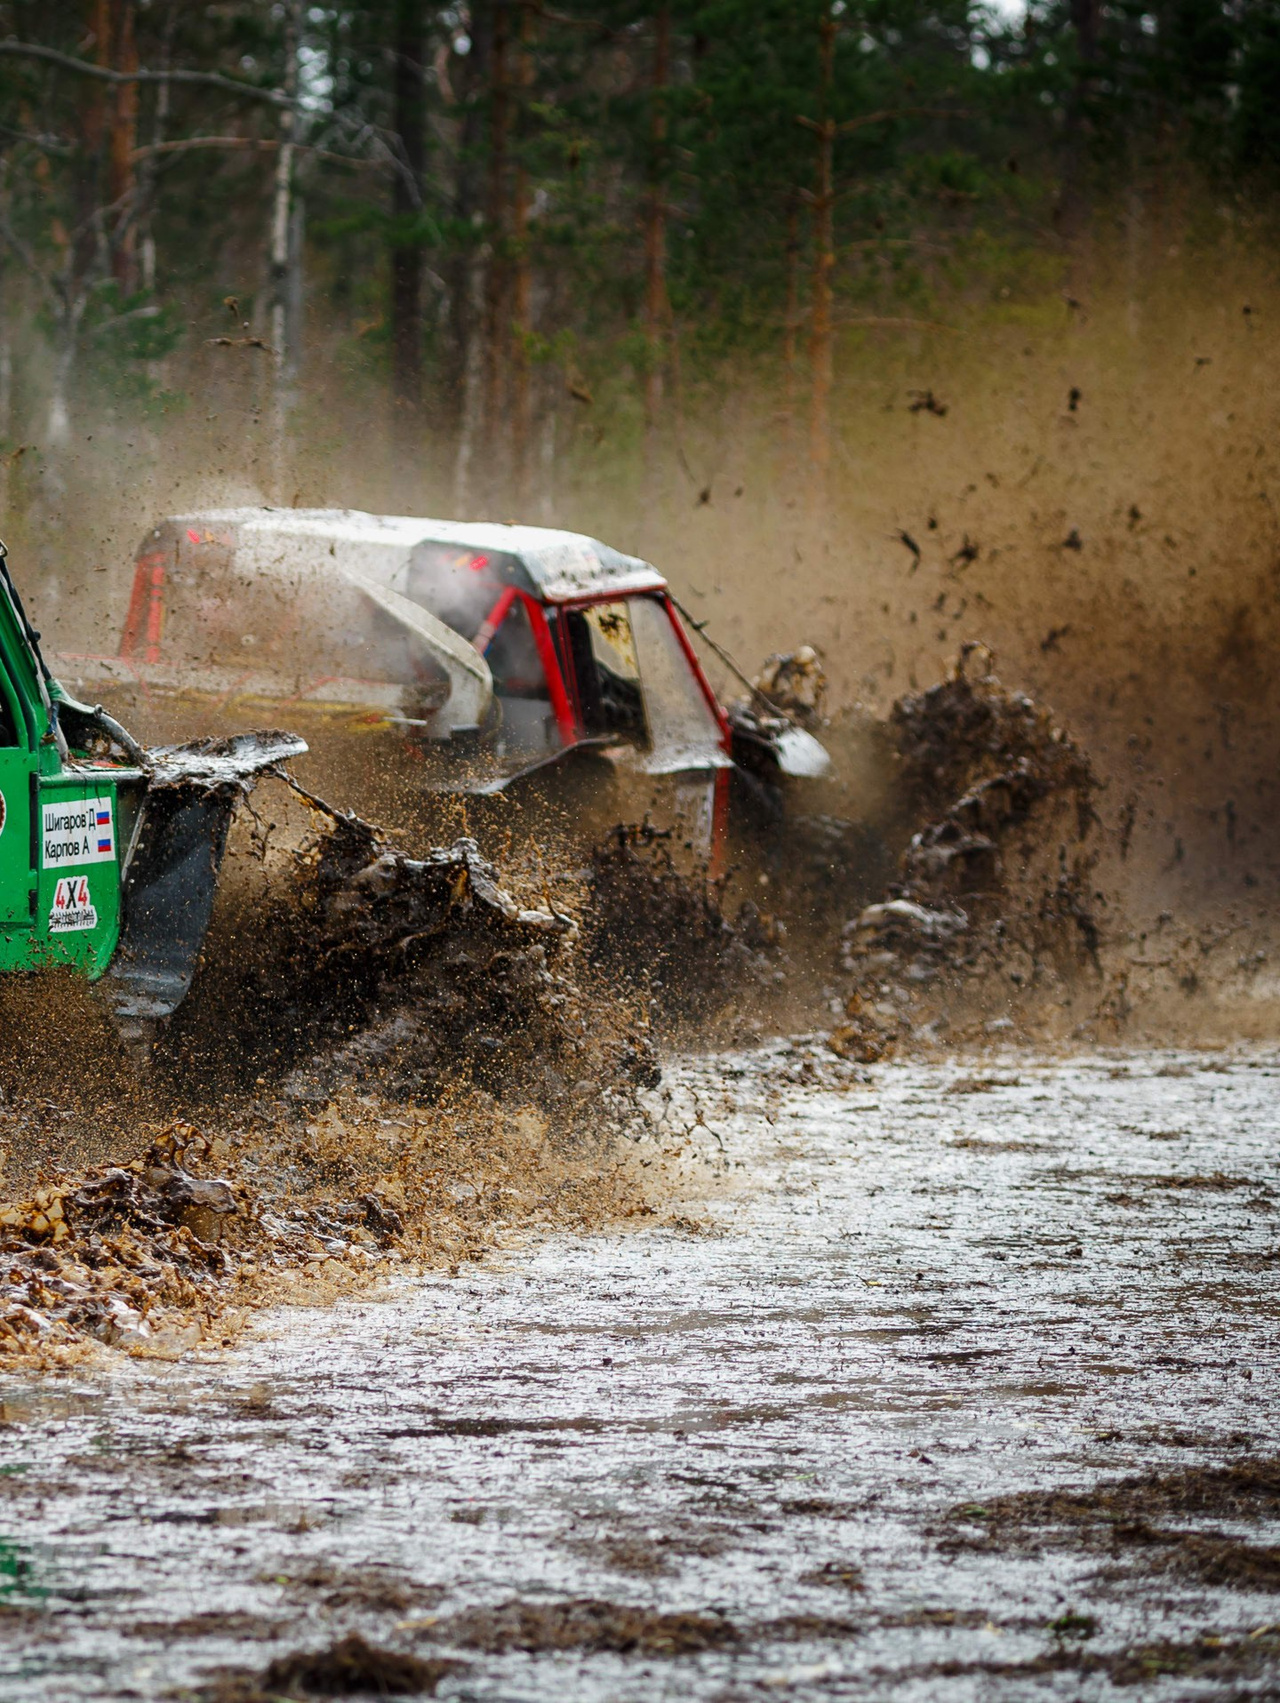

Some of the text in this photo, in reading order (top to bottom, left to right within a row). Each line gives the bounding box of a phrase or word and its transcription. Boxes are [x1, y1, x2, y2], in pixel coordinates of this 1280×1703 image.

[45, 812, 87, 834] Шигаров
[45, 836, 90, 862] Карпов А
